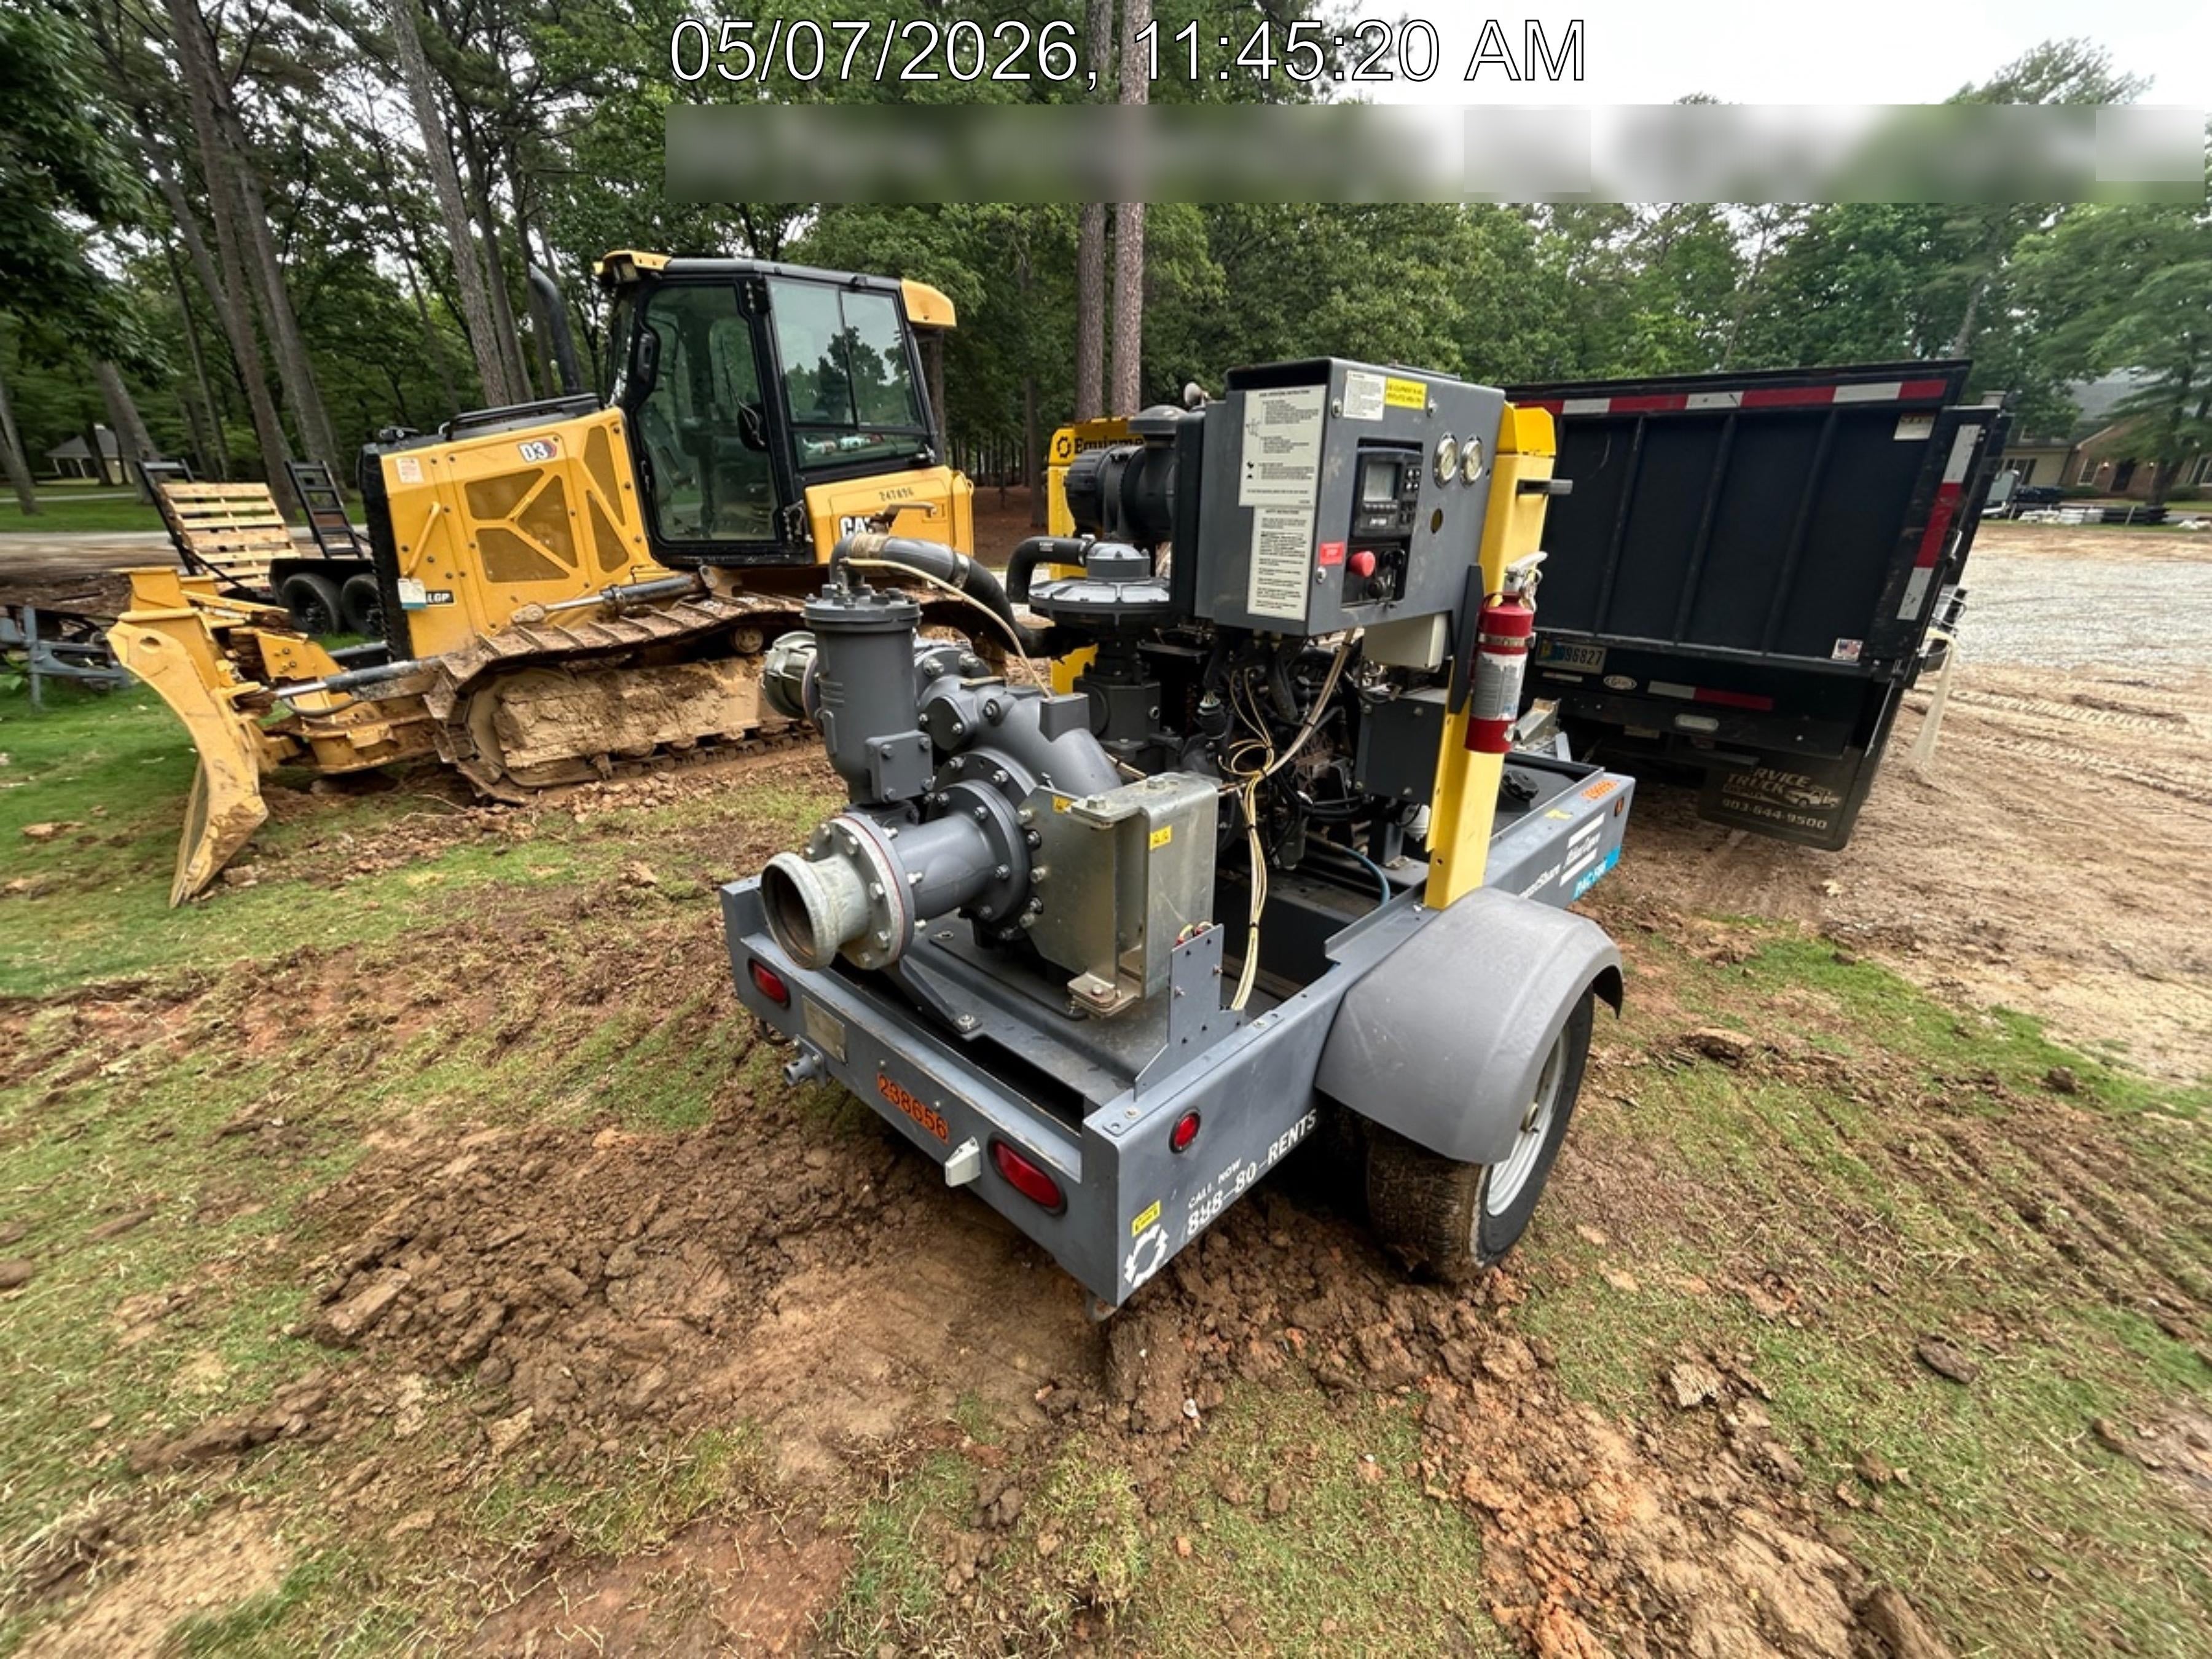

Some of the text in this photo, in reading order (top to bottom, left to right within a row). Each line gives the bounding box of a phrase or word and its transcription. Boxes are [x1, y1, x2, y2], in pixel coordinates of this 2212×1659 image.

[518, 441, 547, 462] D3
[426, 593, 450, 603] LGP
[1728, 774, 1786, 795] TRUCK
[1754, 767, 1811, 788] RVICE
[1188, 1158, 1241, 1209] CALL NOW
